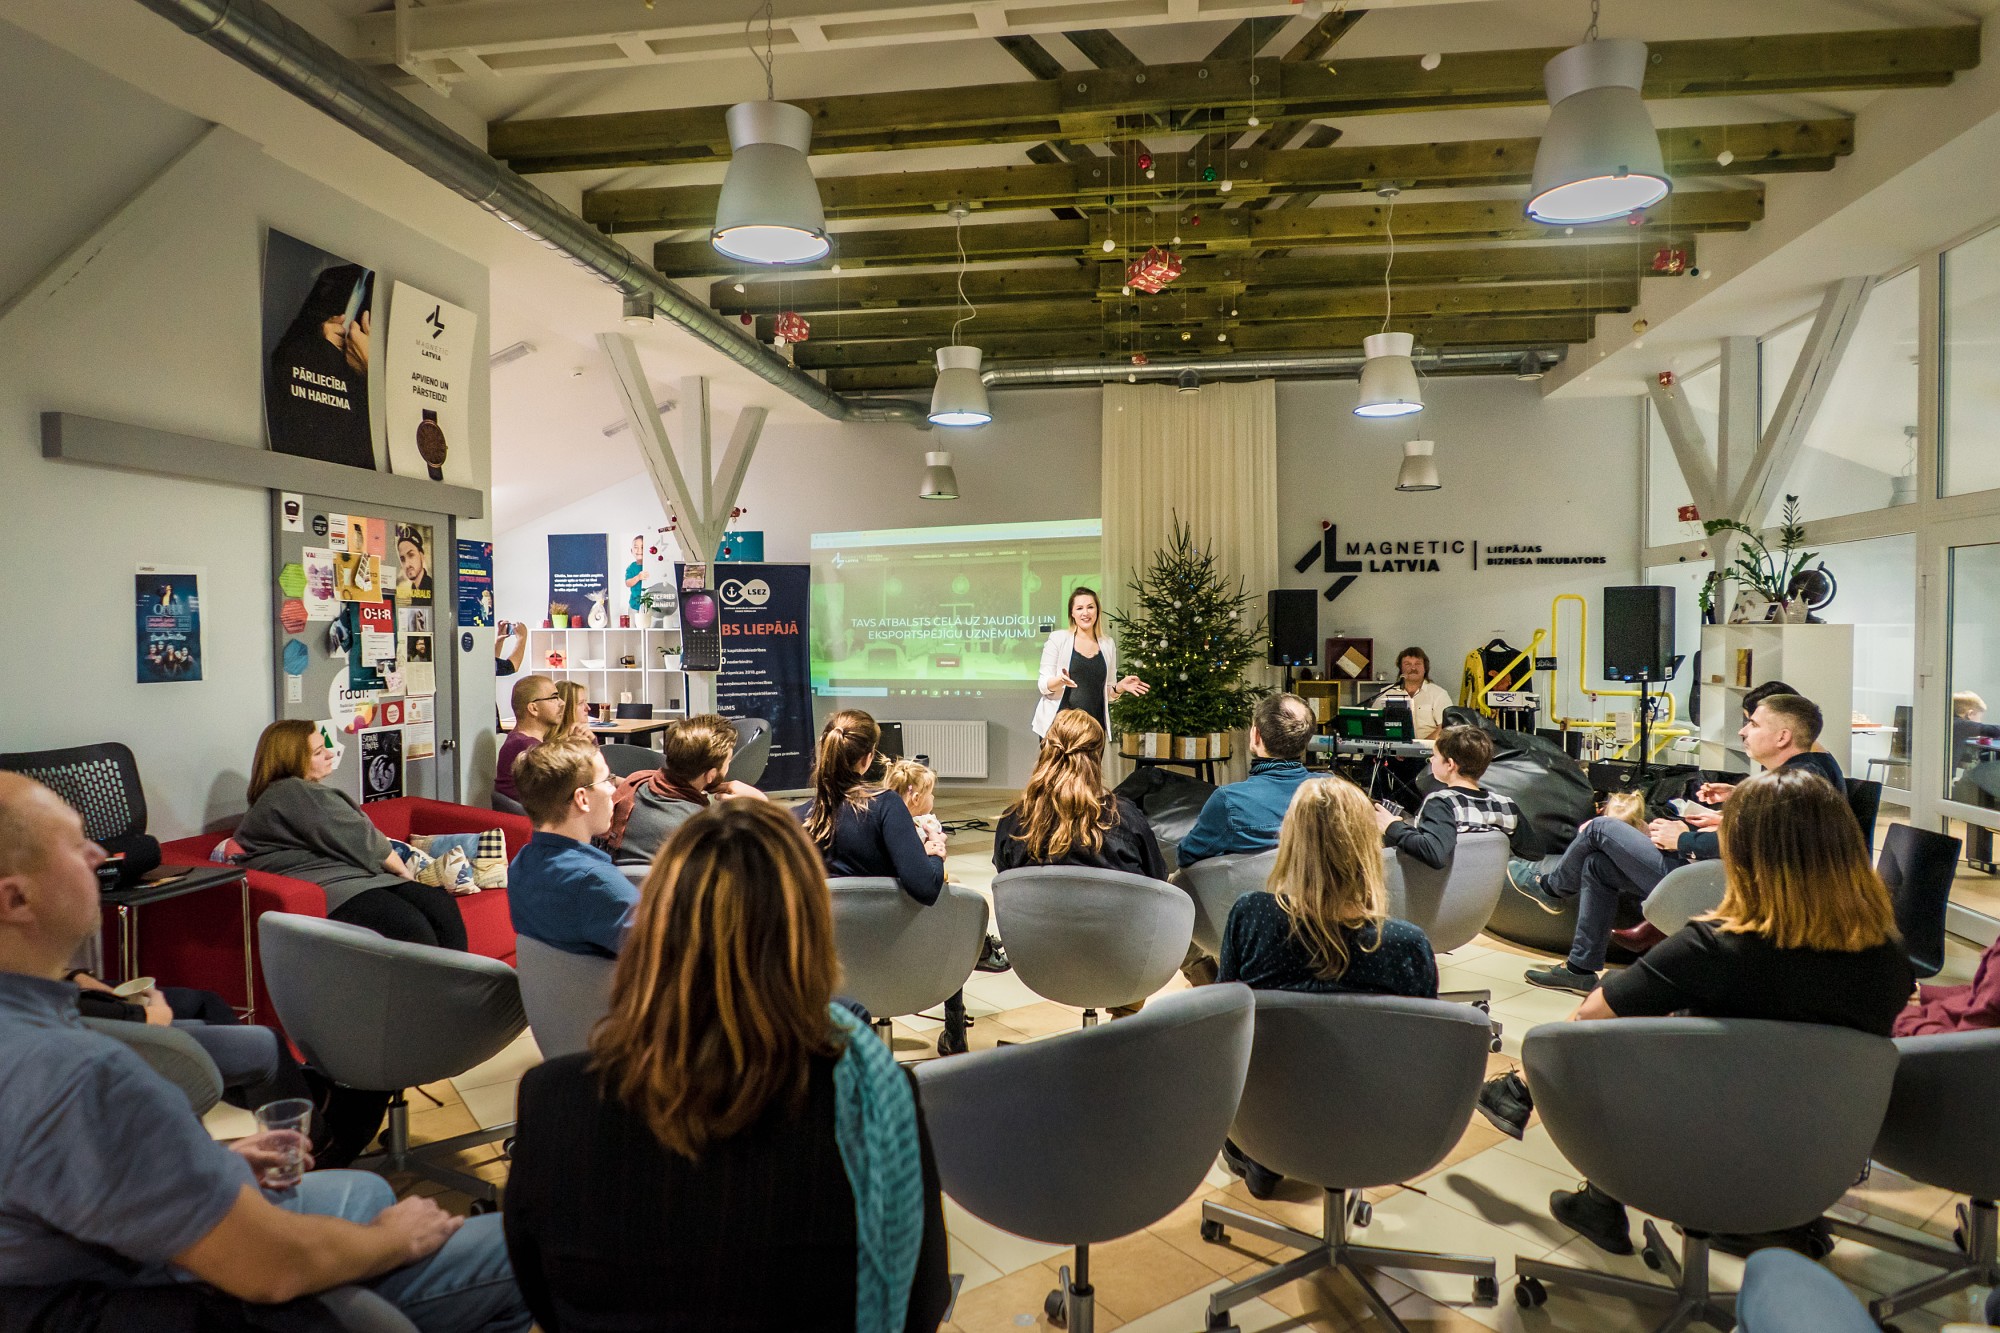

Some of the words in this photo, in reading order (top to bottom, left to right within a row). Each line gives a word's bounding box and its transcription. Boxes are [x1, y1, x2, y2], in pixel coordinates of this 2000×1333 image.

[421, 350, 441, 361] LATVIA
[292, 366, 347, 393] PĀRLIECĪBA
[411, 372, 438, 387] APVIENO
[440, 381, 449, 390] UN
[290, 384, 306, 399] UN
[308, 389, 351, 410] HARIZMA
[1346, 540, 1465, 556] MAGNETIC
[1487, 544, 1542, 554] LIEPĀJAS
[1370, 559, 1440, 573] LATVIA
[1487, 557, 1533, 566] BIZNESA
[1536, 556, 1607, 565] INKUBATORS
[743, 620, 799, 635] LIEPĀJĀ
[851, 618, 876, 627] TAVS
[878, 617, 931, 627] ATBALSTS
[933, 614, 962, 628] CEĻĀ
[965, 616, 980, 626] UZ
[983, 614, 1035, 625] JAUDĪGU
[1038, 615, 1056, 625] UN
[868, 628, 963, 640] EKSPORTSPĒJĪGU
[966, 627, 1036, 641] UZŅĒMUMU
